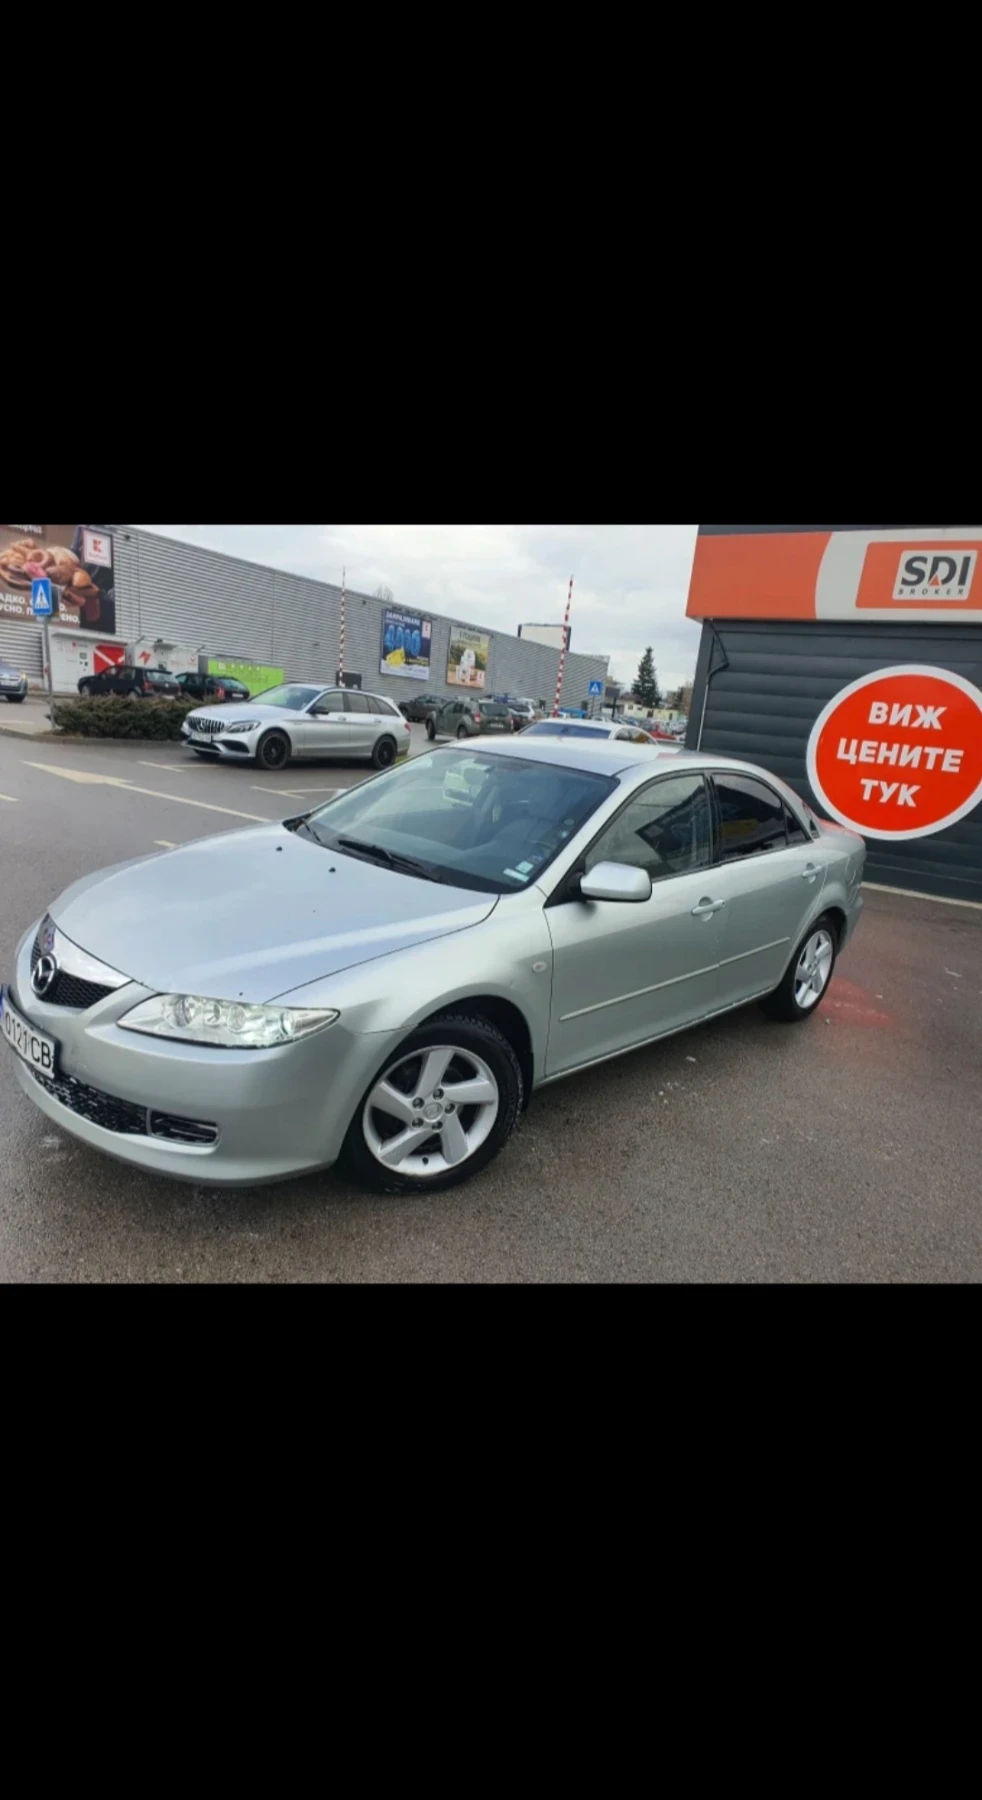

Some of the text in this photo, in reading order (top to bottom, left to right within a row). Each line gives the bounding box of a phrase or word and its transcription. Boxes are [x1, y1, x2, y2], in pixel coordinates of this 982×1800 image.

[901, 555, 971, 586] SDI
[898, 588, 964, 596] BROKER
[868, 701, 947, 730] ВИЖ
[836, 737, 964, 773] ЦЕНИТЕ
[860, 778, 921, 808] ТУК
